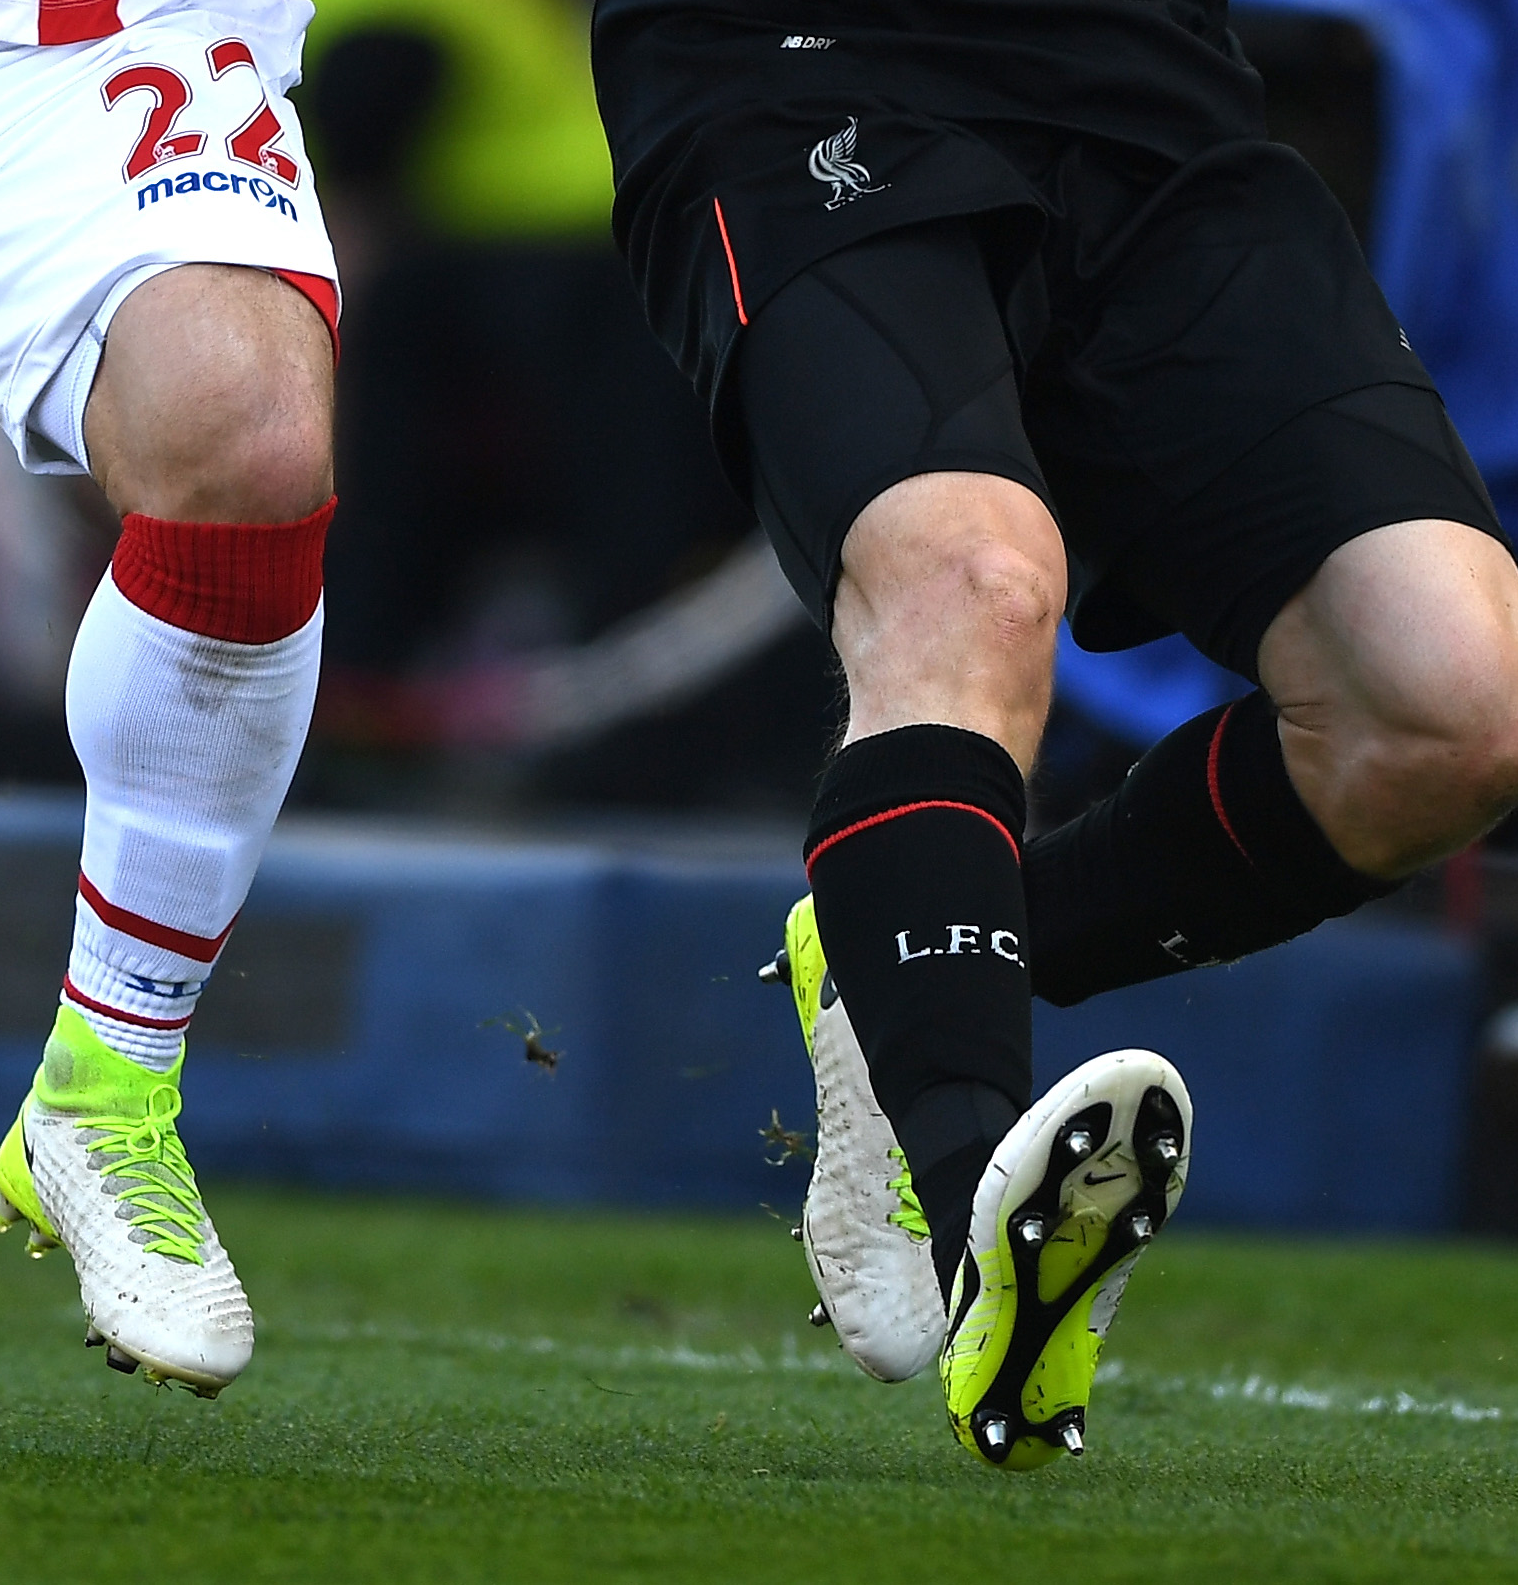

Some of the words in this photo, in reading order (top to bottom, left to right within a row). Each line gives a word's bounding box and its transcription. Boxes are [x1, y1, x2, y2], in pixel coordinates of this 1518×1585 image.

[802, 36, 836, 50] DRY
[100, 37, 300, 190] 22
[138, 171, 298, 222] macron
